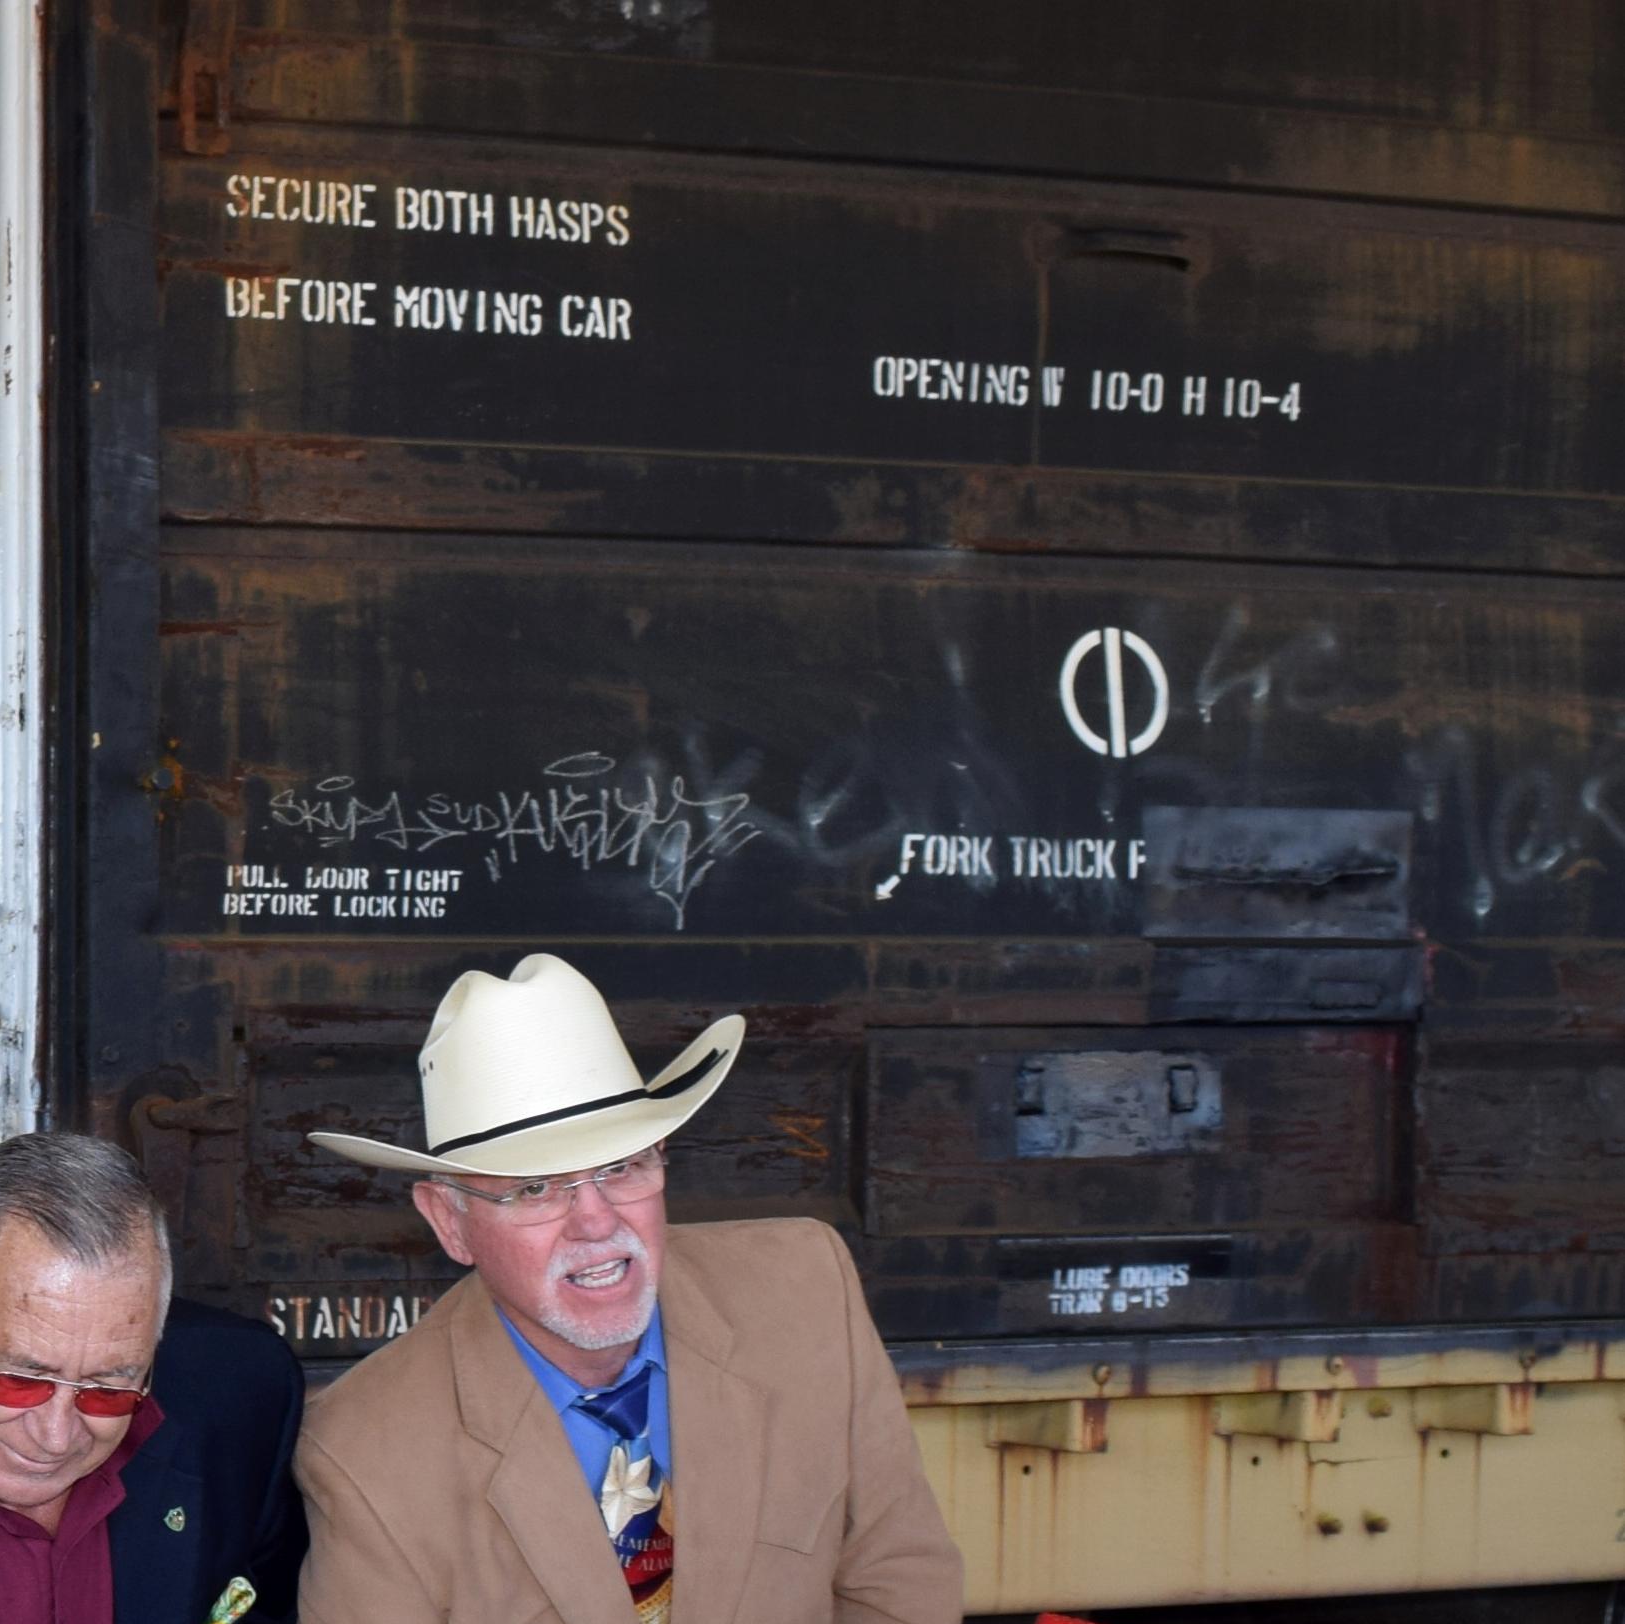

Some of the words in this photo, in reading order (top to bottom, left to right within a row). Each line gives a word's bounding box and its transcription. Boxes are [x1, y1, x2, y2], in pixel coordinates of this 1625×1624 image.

[226, 174, 377, 228] SECURE
[395, 187, 494, 236] BOTH
[510, 195, 630, 247] HASPS
[224, 276, 377, 326] BEFORE
[394, 284, 543, 336] MOVING
[560, 294, 632, 341] CAR
[873, 355, 1030, 406] OPENING
[1090, 369, 1164, 413] 10-0
[1181, 375, 1207, 416] H
[1223, 377, 1301, 421] 10-4
[226, 865, 288, 888] PULL
[305, 867, 370, 890] DOOR
[384, 869, 463, 892] TIGHT
[900, 833, 994, 876] FORK
[1008, 836, 1116, 879] TRUCK
[223, 893, 319, 916] BEFORE
[334, 895, 446, 918] LOCKING
[1053, 1264, 1112, 1290] LUBE
[1119, 1263, 1190, 1289] DOORS
